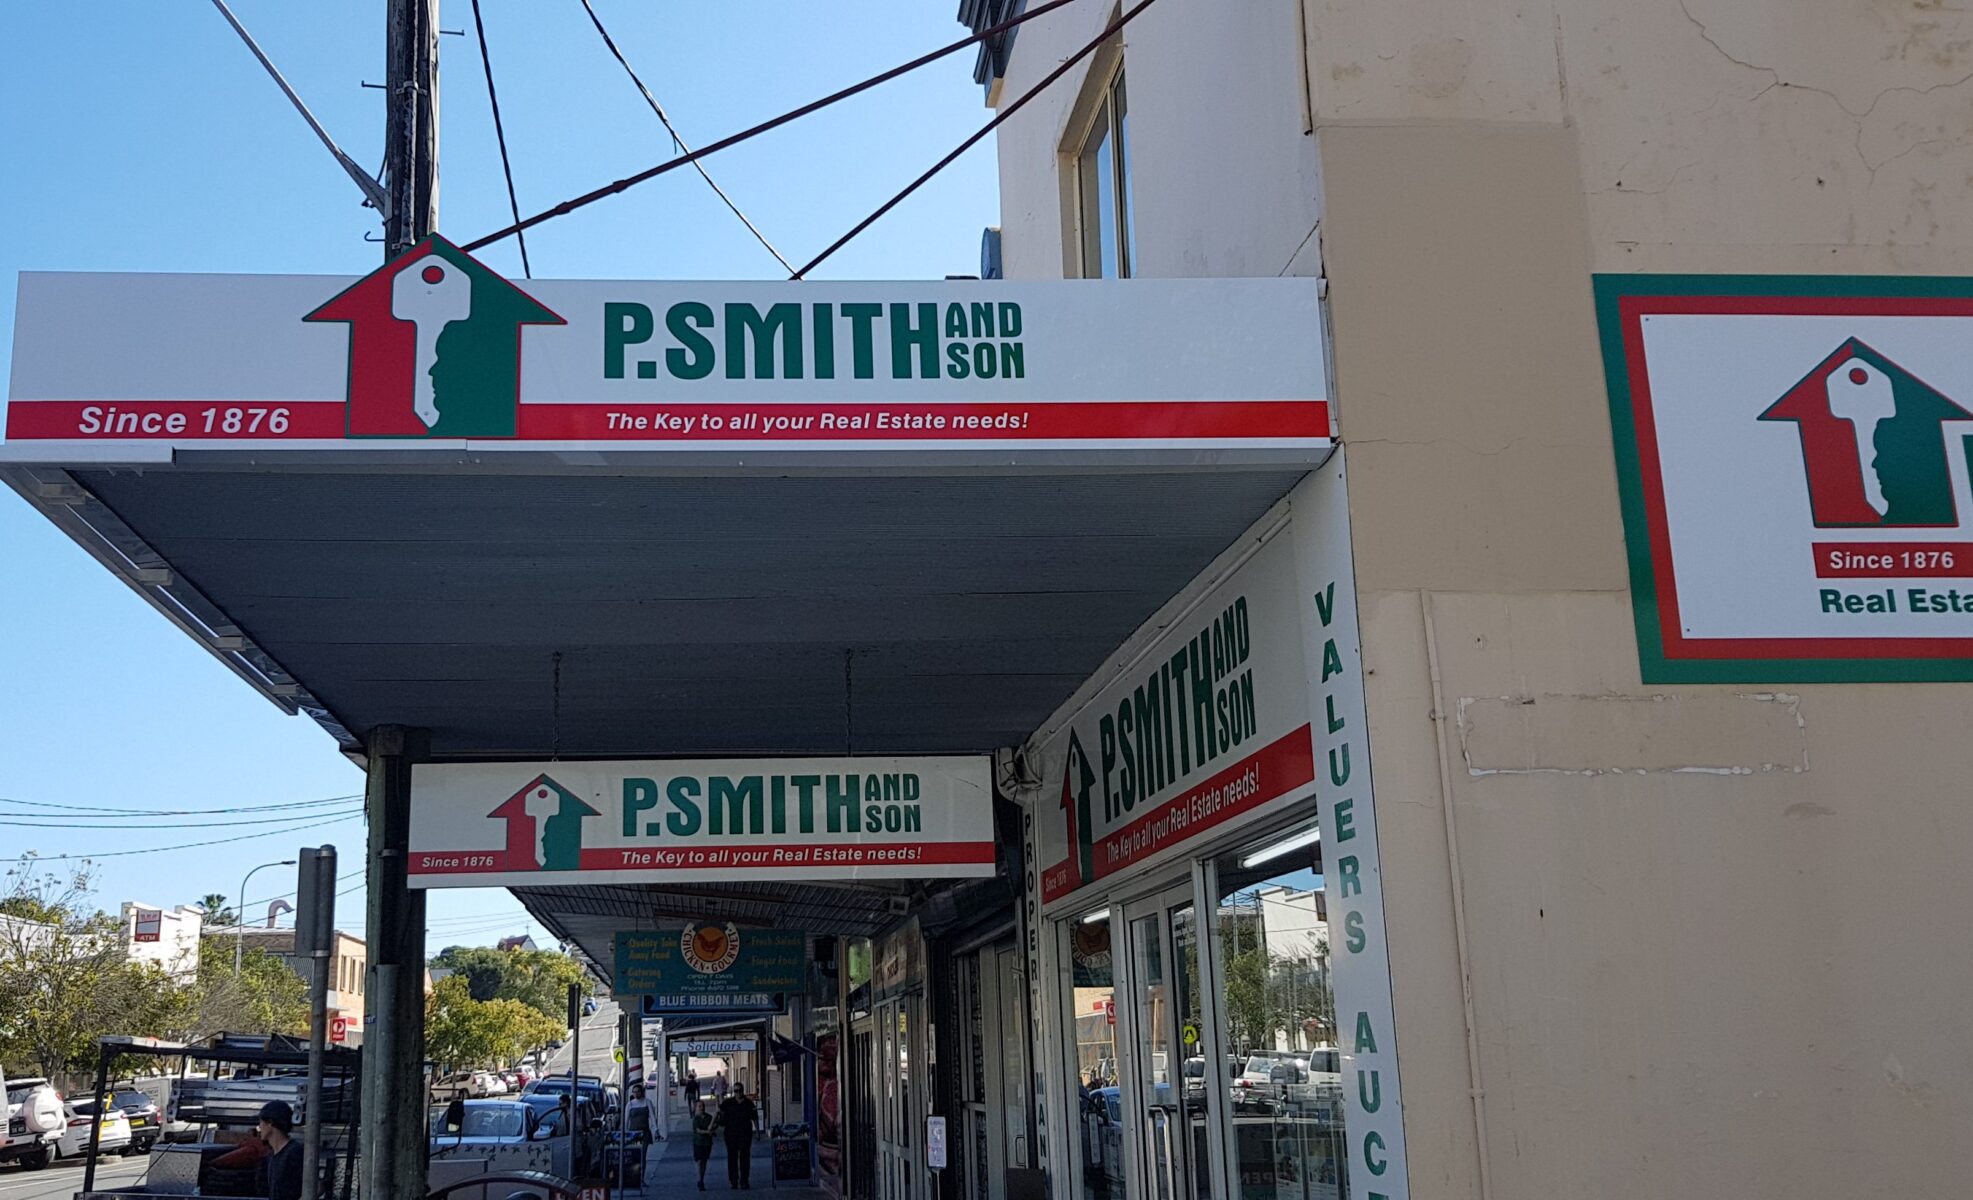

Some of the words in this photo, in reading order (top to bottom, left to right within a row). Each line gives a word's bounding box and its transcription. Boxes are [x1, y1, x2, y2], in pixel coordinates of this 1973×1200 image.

[945, 302, 1023, 338] AND
[604, 301, 941, 380] P.SMITH
[946, 342, 1025, 379] SON
[79, 406, 188, 434] Since
[200, 407, 290, 434] 1876
[606, 412, 648, 430] The
[654, 412, 697, 434] Key
[701, 414, 724, 430] to
[729, 412, 757, 430] all
[762, 416, 814, 434] your
[820, 412, 871, 430] Real
[876, 412, 946, 430] Estate
[952, 412, 1029, 430] needs!
[1829, 551, 1894, 569] Since
[1901, 551, 1955, 569] 1876
[1820, 588, 1897, 614] Real
[1214, 595, 1251, 683] AND
[1099, 626, 1218, 824] P.SMITH
[1216, 668, 1257, 754] SON
[864, 773, 921, 802] AND
[622, 773, 861, 837] P.SMITH
[865, 804, 922, 833] SON
[1106, 840, 1119, 864] The
[1120, 835, 1132, 861] Key
[1133, 830, 1141, 851] to
[1141, 821, 1151, 848] all
[1152, 816, 1170, 849] your
[1171, 800, 1190, 833] Real
[1191, 787, 1221, 823] Estate
[1223, 761, 1260, 807] needs!
[422, 855, 461, 869] Since
[463, 855, 494, 868] 1876
[621, 851, 652, 866] The
[656, 850, 685, 868] Key
[688, 851, 704, 865] to
[707, 849, 728, 863] all
[731, 851, 769, 867] your
[773, 848, 810, 862] Real
[813, 847, 863, 861] Estate
[867, 846, 922, 861] needs!
[682, 932, 704, 972] CHICKEN
[711, 931, 739, 973] GOURMET
[659, 995, 686, 1007] BLUE
[690, 994, 730, 1006] RIBBON
[733, 993, 769, 1005] MEATS
[687, 1041, 742, 1052] Solicitors
[1354, 1011, 1390, 1200] AUC
